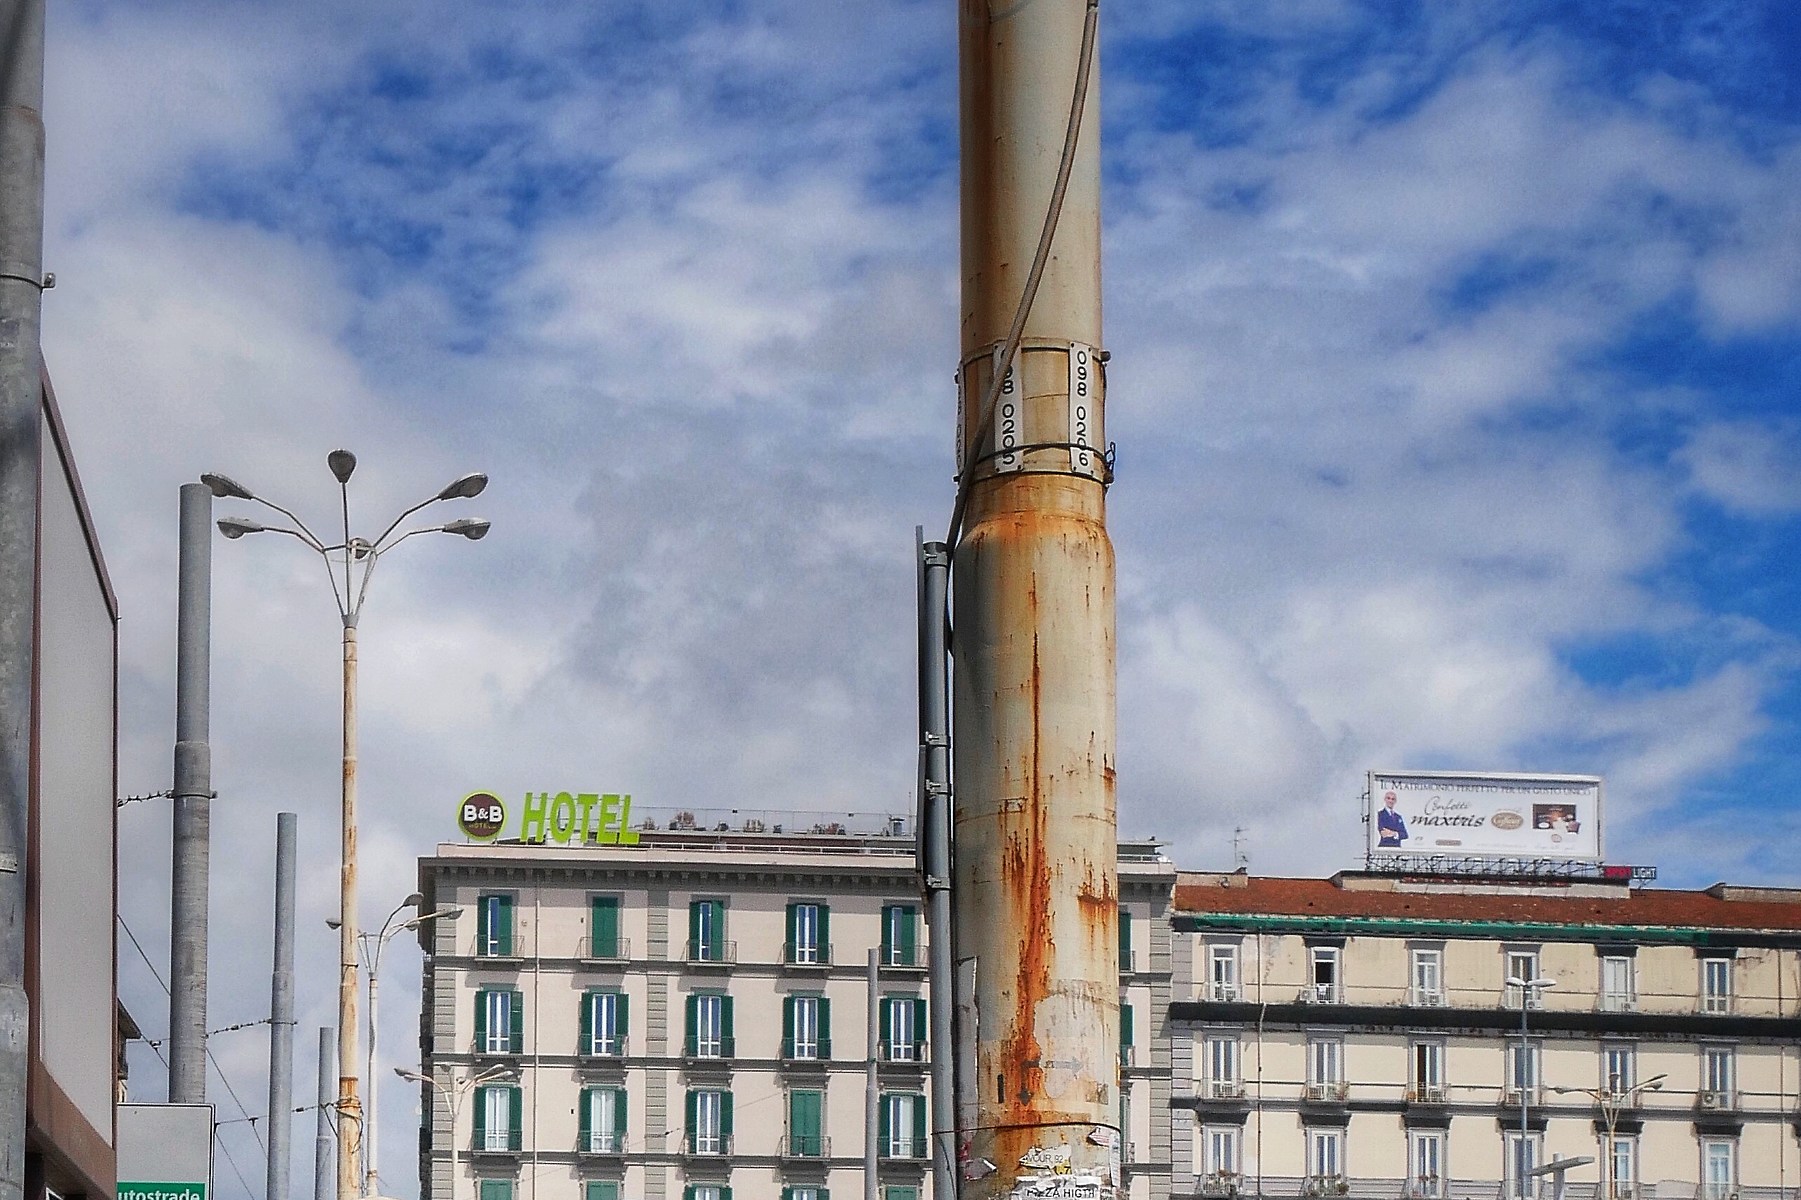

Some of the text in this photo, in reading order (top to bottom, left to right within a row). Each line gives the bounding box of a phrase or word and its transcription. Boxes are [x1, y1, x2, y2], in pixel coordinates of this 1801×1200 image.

[1076, 350, 1088, 397] 098
[463, 805, 503, 822] B&B
[520, 792, 640, 845] HOTEL
[1410, 812, 1486, 828] maxtris
